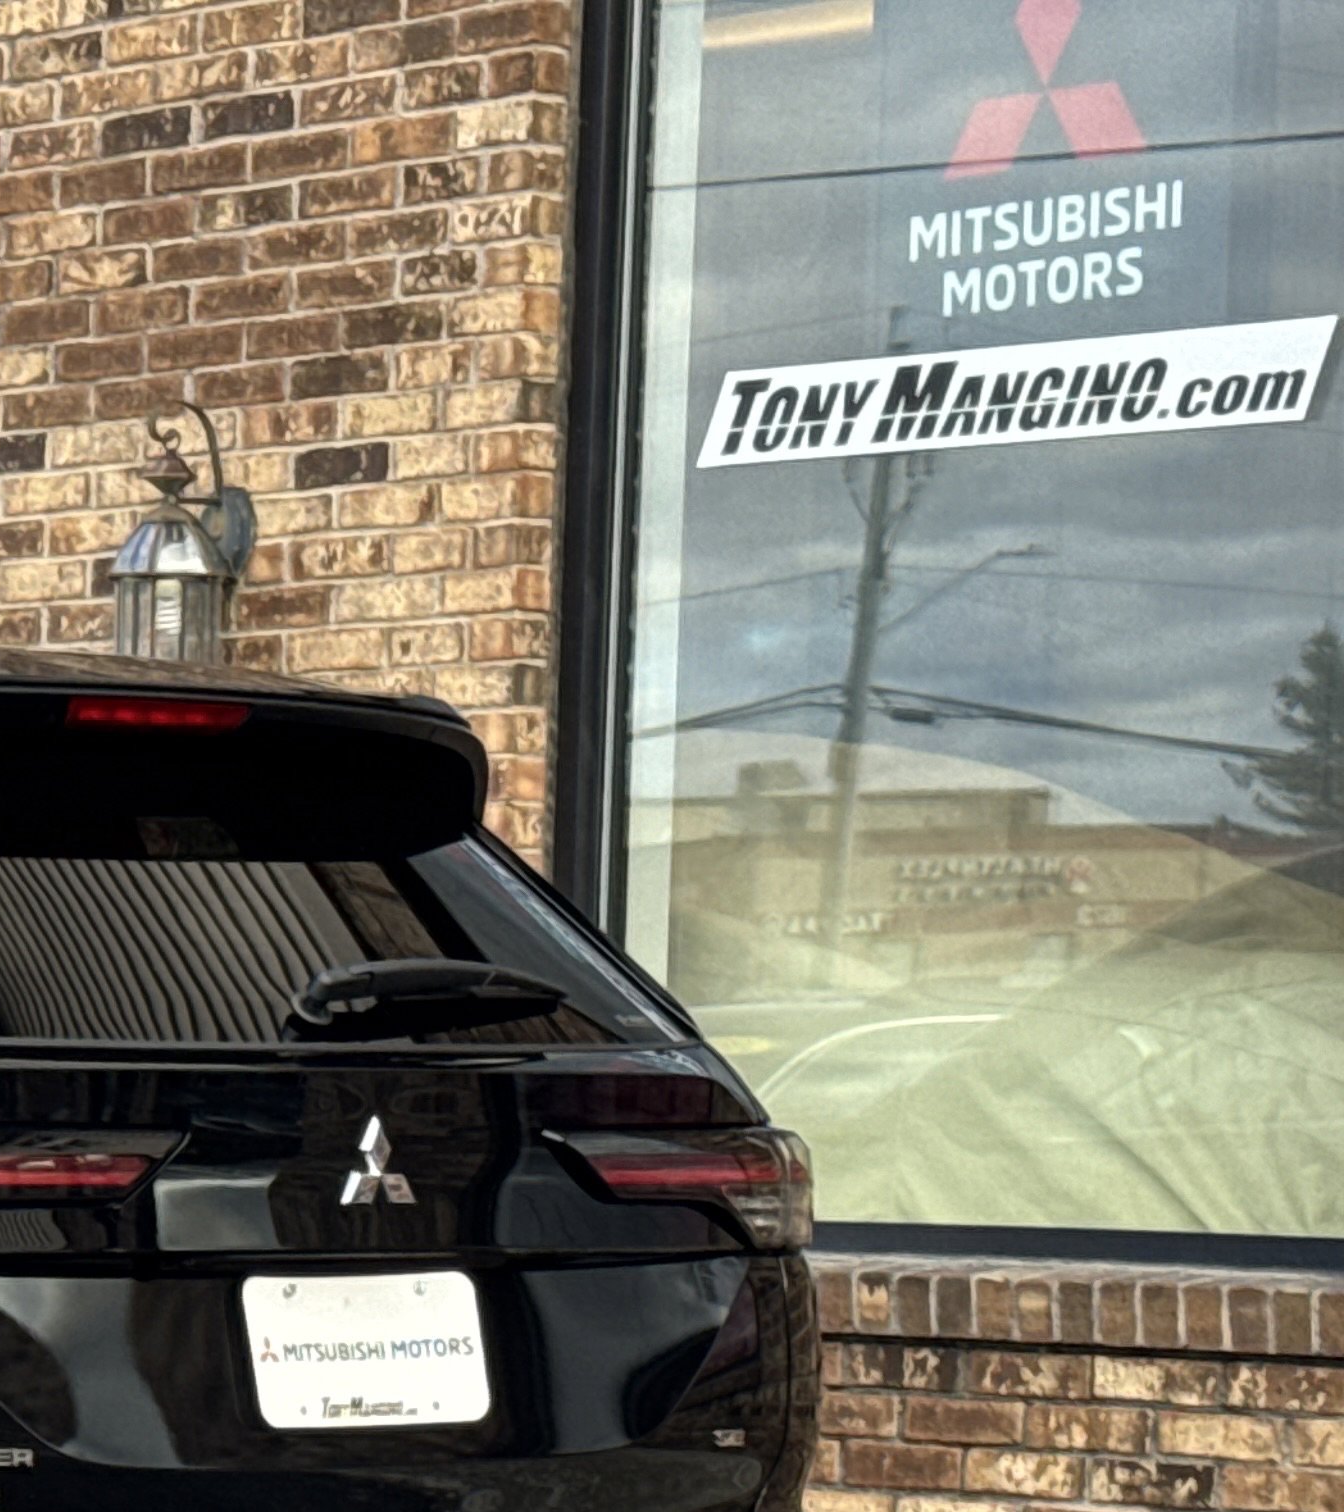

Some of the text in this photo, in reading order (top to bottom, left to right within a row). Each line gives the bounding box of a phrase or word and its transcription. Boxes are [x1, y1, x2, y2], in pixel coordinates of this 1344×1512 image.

[908, 179, 1184, 262] MITSUBISHI
[941, 247, 1144, 318] MOTORS
[283, 1336, 474, 1363] MITSUBISHI MOTORS
